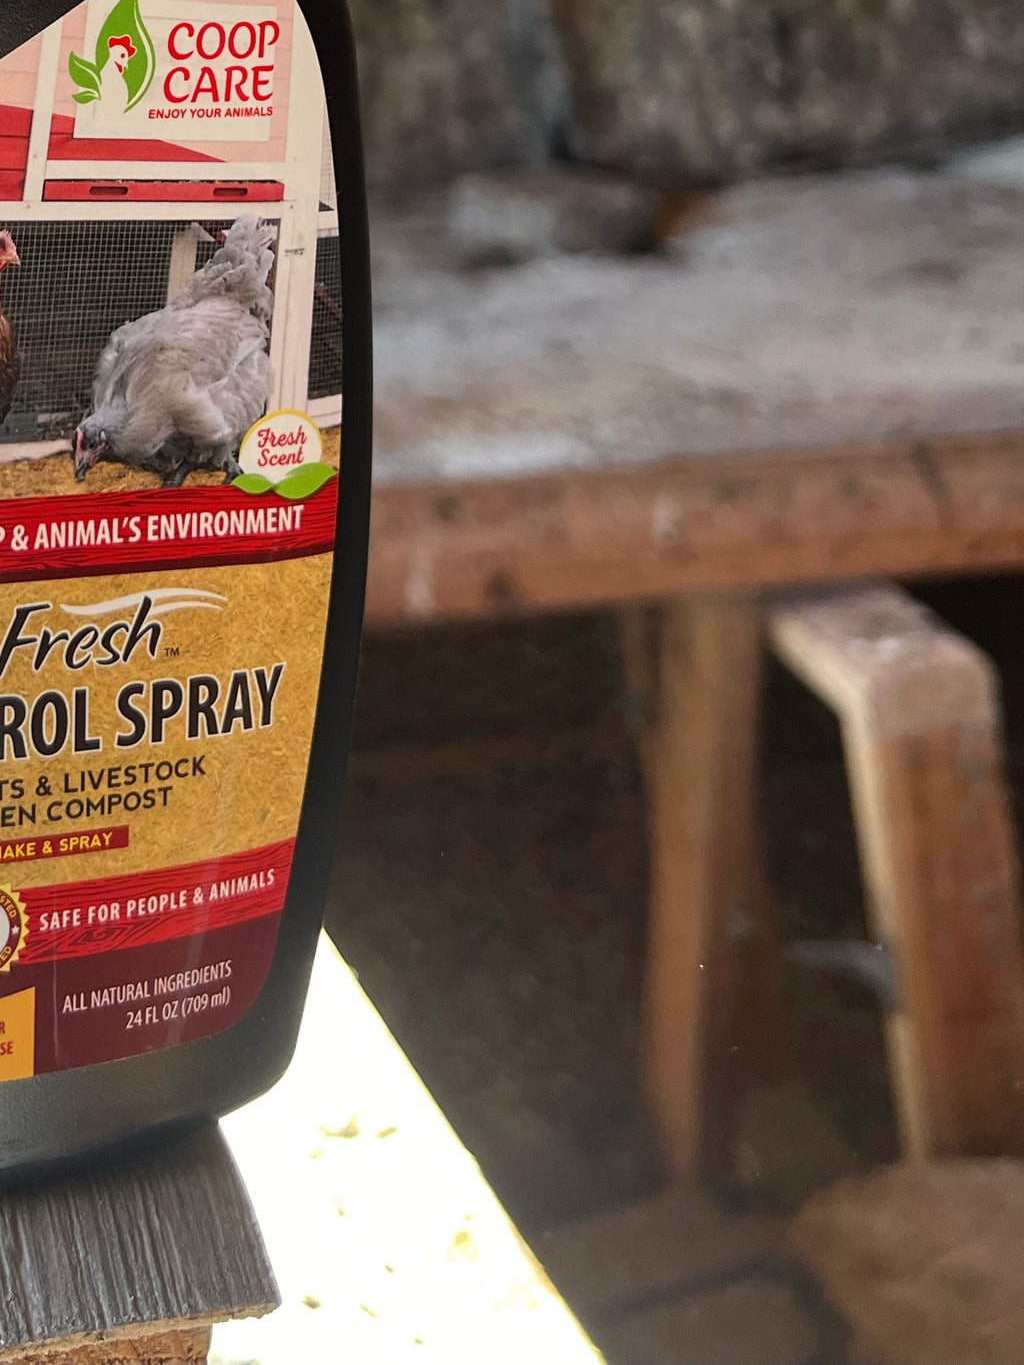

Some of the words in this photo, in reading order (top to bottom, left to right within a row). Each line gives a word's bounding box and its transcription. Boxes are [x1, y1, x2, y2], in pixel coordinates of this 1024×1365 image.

[167, 20, 280, 60] COOP
[163, 64, 274, 104] CARE
[148, 108, 187, 120] ENJOY
[190, 107, 222, 119] YOUR
[224, 106, 274, 118] ANIMALS
[257, 425, 307, 449] Fresh
[258, 446, 304, 467] Scent
[11, 524, 29, 552] &
[34, 516, 141, 550] ANIMAL'S
[147, 504, 304, 541] ENVIRONMENT
[116, 663, 285, 747] SPRAY
[35, 775, 53, 797] &
[63, 754, 207, 794] LIVESTOCK
[47, 786, 173, 821] COMPOST
[42, 840, 53, 854] &
[59, 832, 113, 853] SPRAY
[39, 907, 82, 932] SAFE
[88, 902, 120, 925] FOR
[126, 889, 187, 918] PEOPLE
[193, 886, 204, 904] &
[208, 868, 275, 901] ANIMALS
[62, 993, 87, 1014] ALL
[91, 981, 151, 1009] NATURAL
[154, 960, 233, 997] INGREDIENTS
[125, 1010, 142, 1030] 24
[145, 1008, 159, 1026] FL
[162, 1000, 179, 1021] OZ
[181, 995, 208, 1018] (709
[210, 985, 231, 1007] ml)
